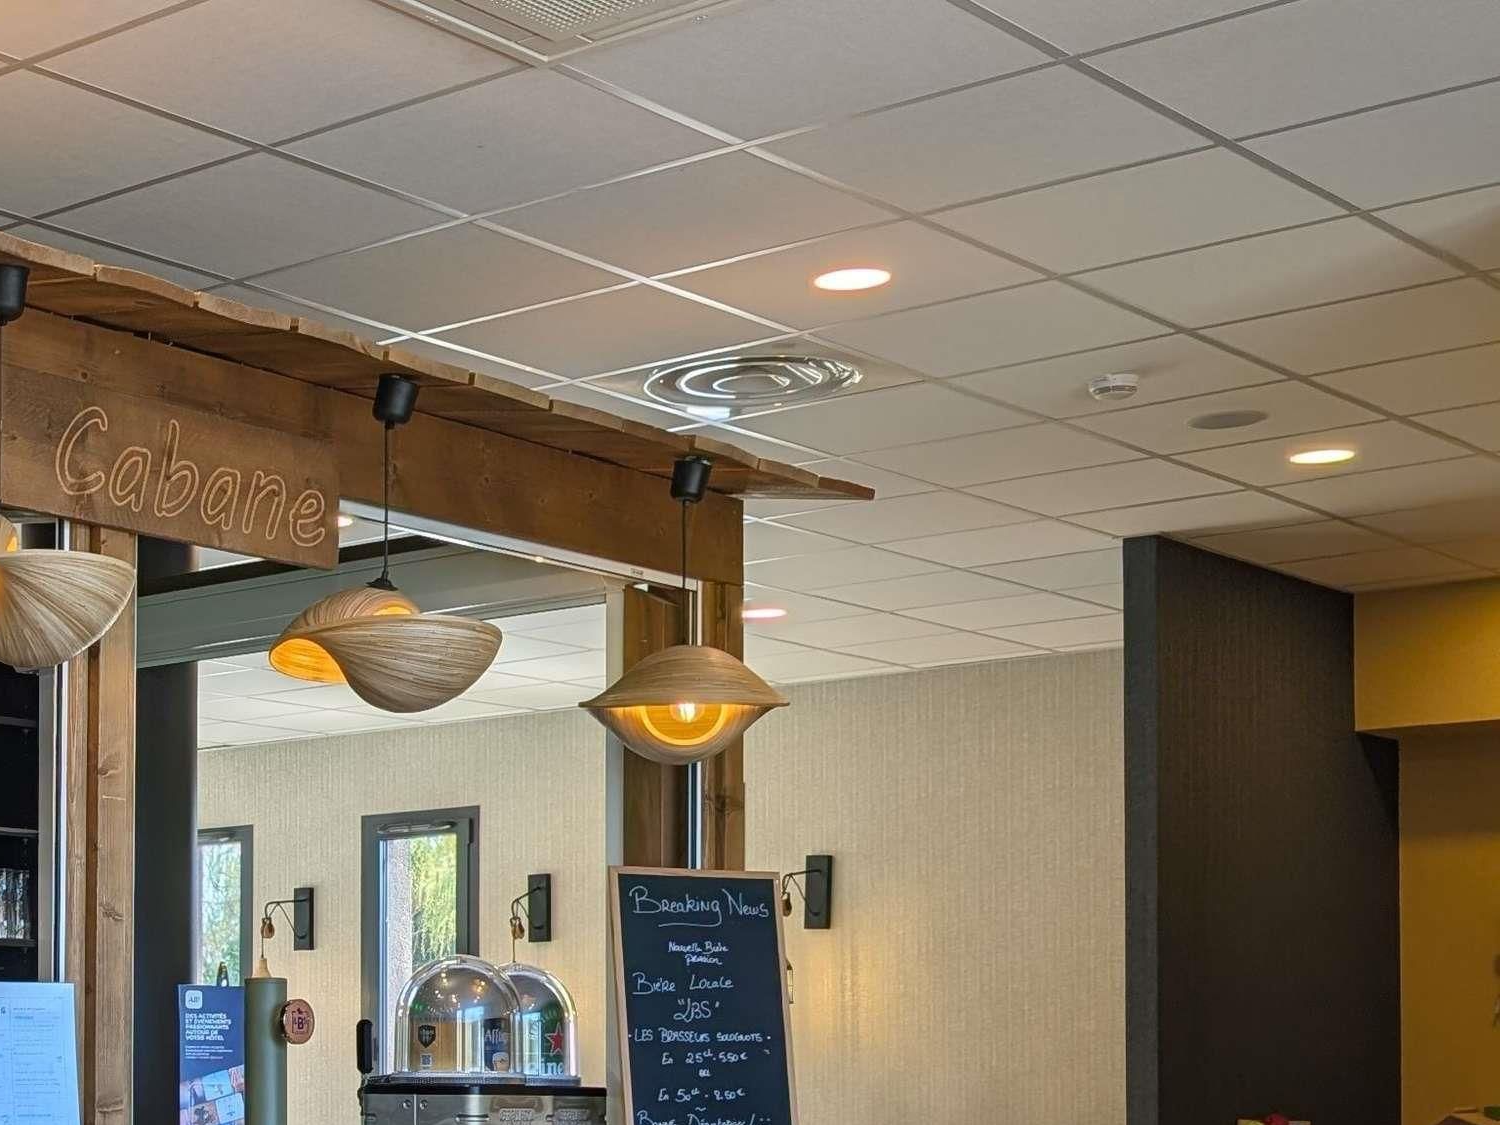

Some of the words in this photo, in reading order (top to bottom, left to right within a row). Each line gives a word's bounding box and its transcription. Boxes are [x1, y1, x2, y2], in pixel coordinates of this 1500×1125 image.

[56, 406, 326, 547] Cabane
[629, 885, 722, 928] Breaking
[721, 888, 770, 918] News
[689, 974, 735, 990] Locale
[633, 1027, 654, 1042] LES
